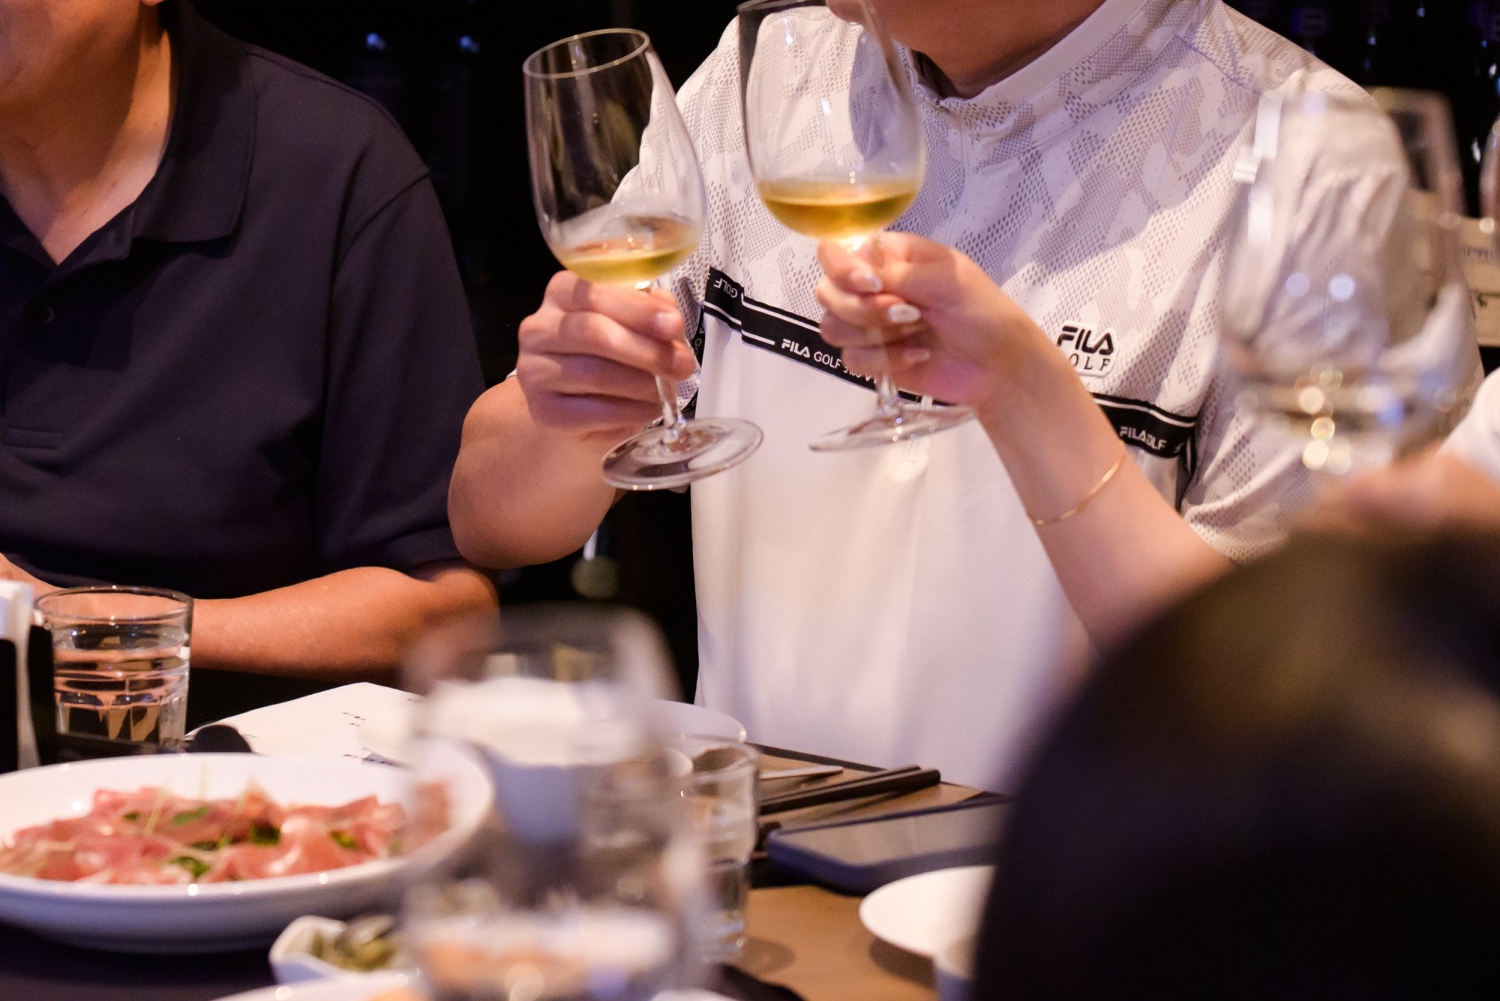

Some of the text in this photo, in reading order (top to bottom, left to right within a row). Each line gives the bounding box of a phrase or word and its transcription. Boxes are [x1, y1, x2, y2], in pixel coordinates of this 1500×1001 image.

[781, 338, 842, 369] FILA GOLF
[1056, 325, 1114, 355] FILA
[1069, 353, 1111, 371] OLF
